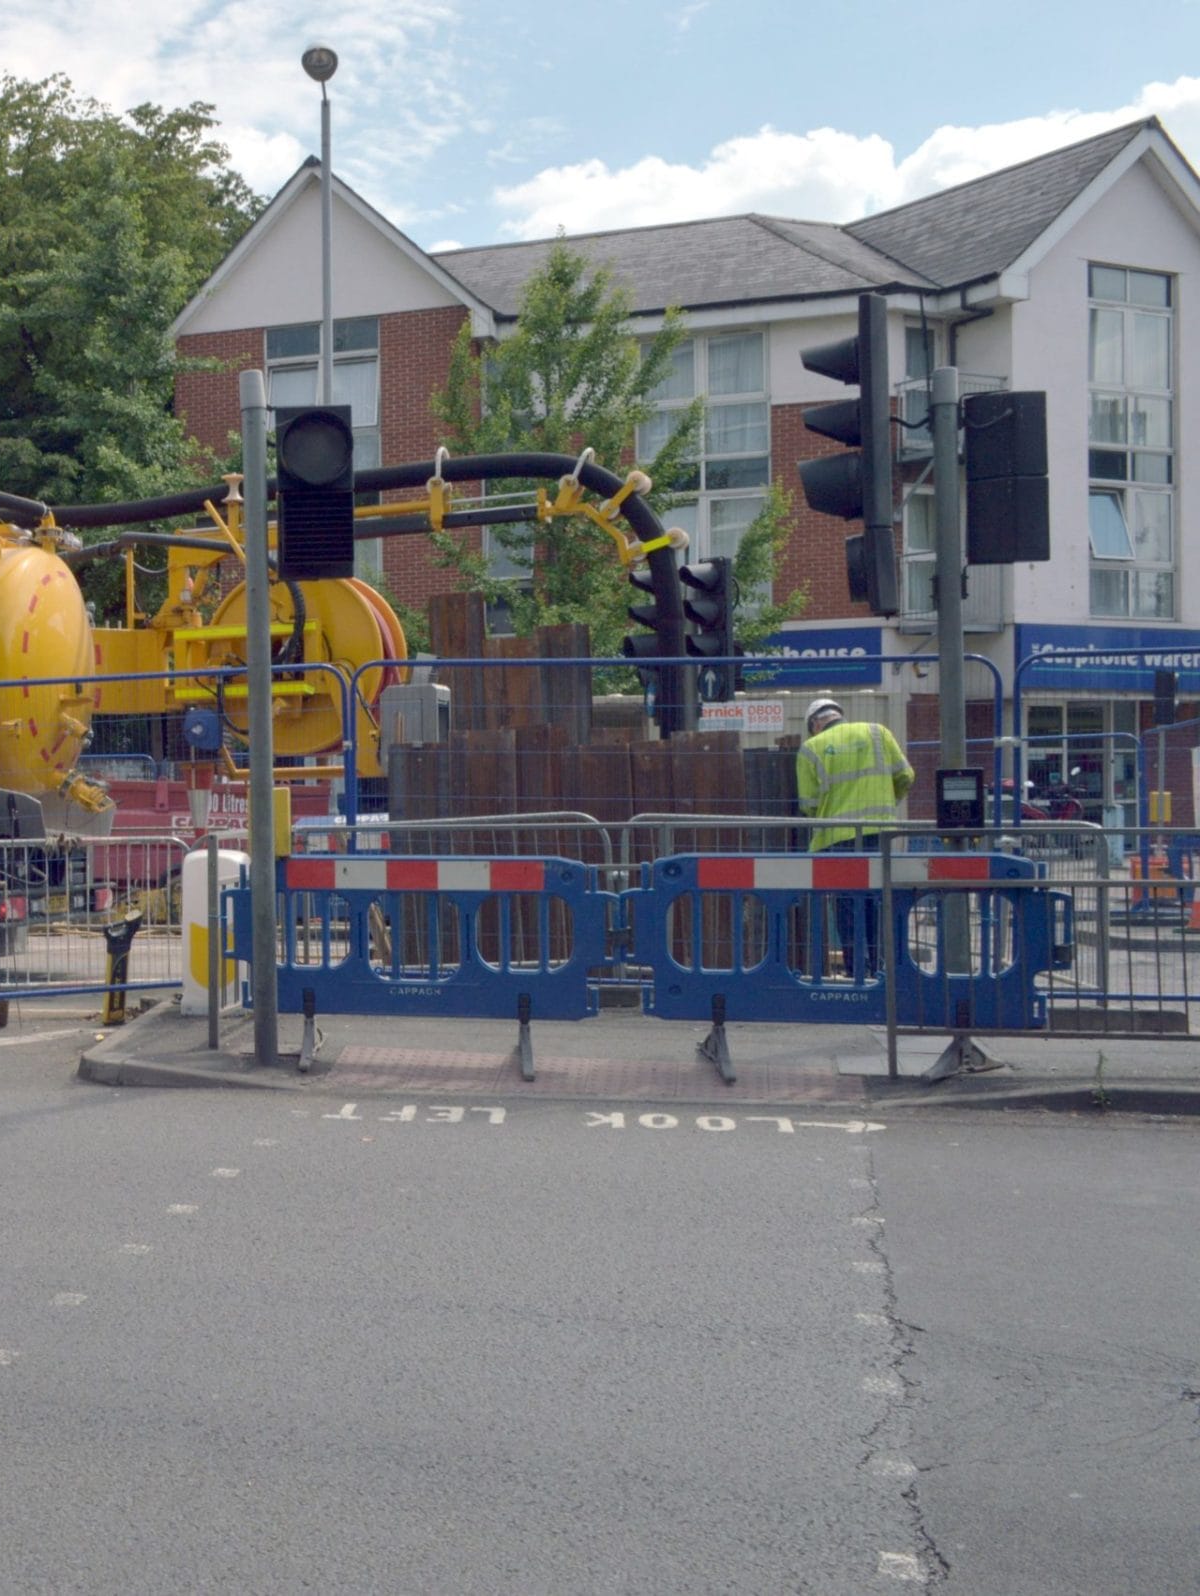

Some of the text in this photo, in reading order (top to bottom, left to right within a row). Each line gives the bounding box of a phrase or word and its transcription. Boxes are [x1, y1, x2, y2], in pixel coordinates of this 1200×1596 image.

[702, 706, 743, 718] ernick
[810, 992, 869, 1002] CAPPAGH
[323, 1103, 794, 1132] LOOK LEFT
